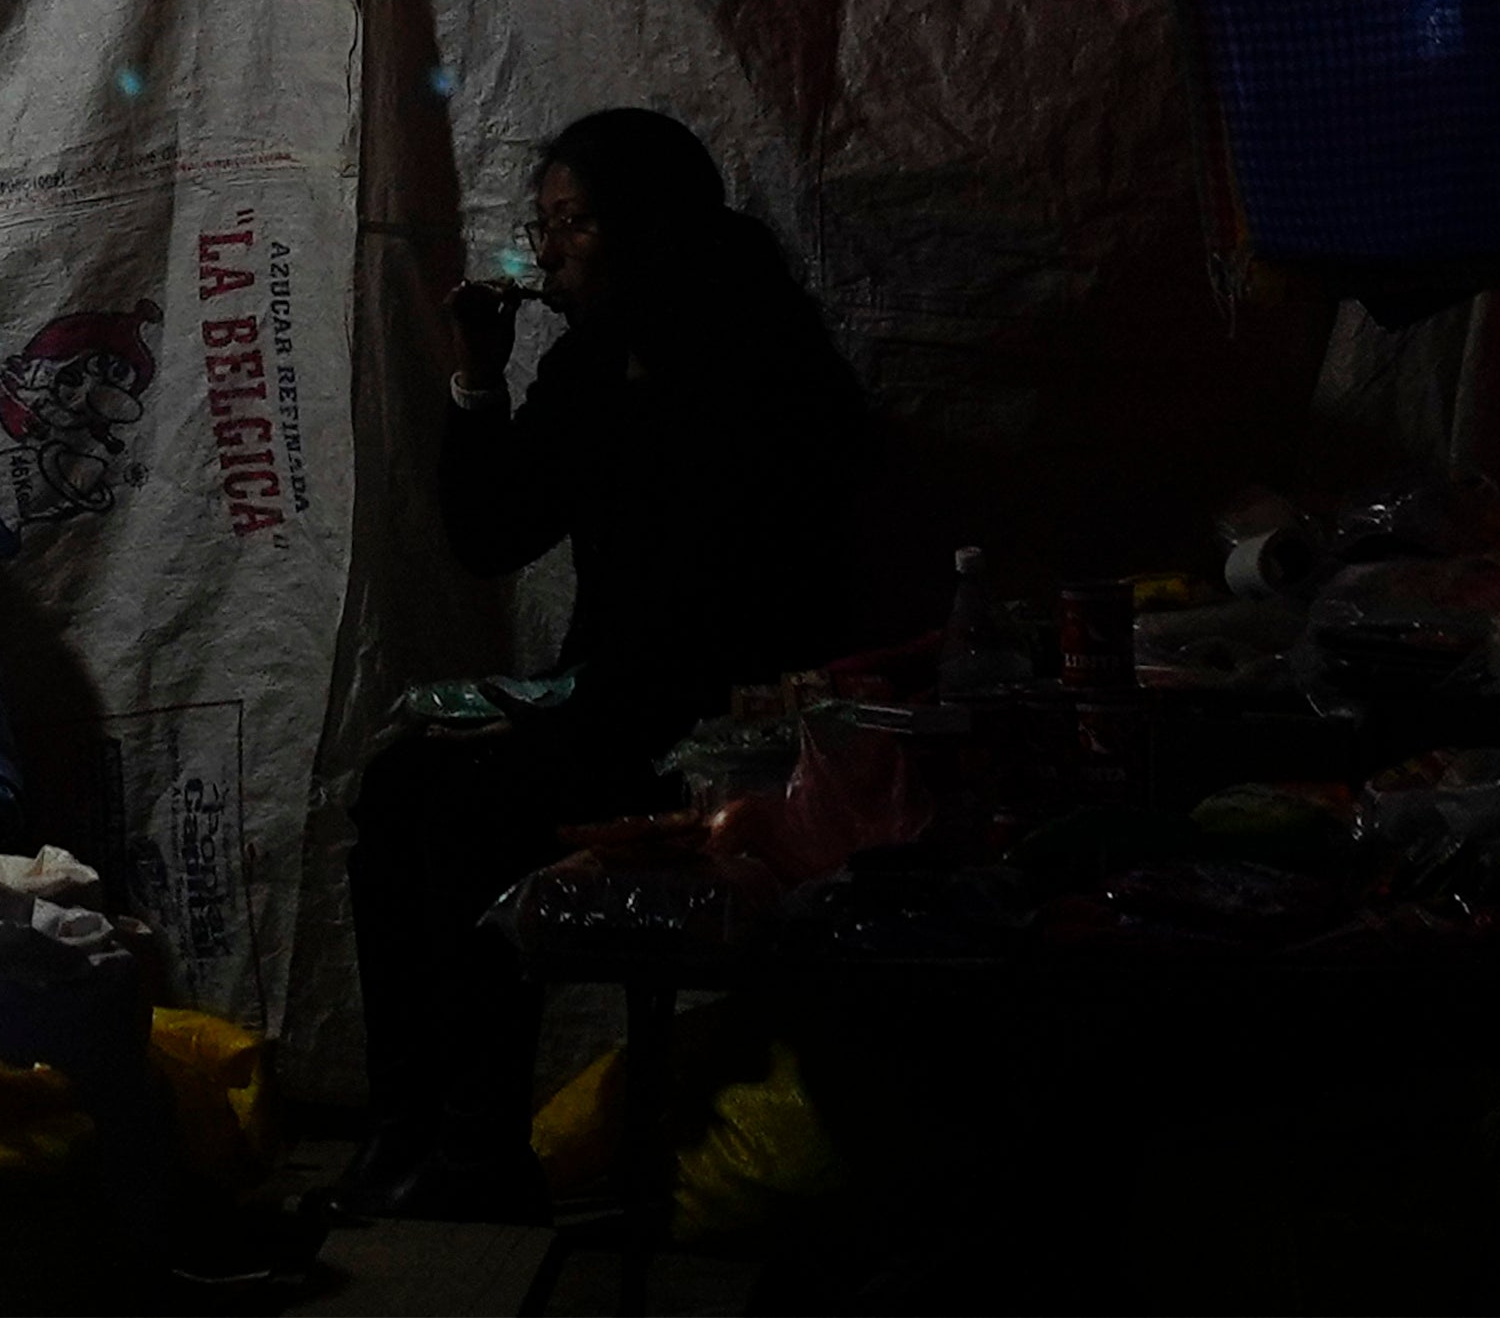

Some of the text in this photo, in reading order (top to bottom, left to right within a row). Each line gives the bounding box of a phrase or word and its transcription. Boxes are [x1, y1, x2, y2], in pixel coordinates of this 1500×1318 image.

[198, 207, 255, 301] "LA
[200, 315, 290, 551] BELGICA"
[269, 241, 311, 514] AZUCAR REFINADA
